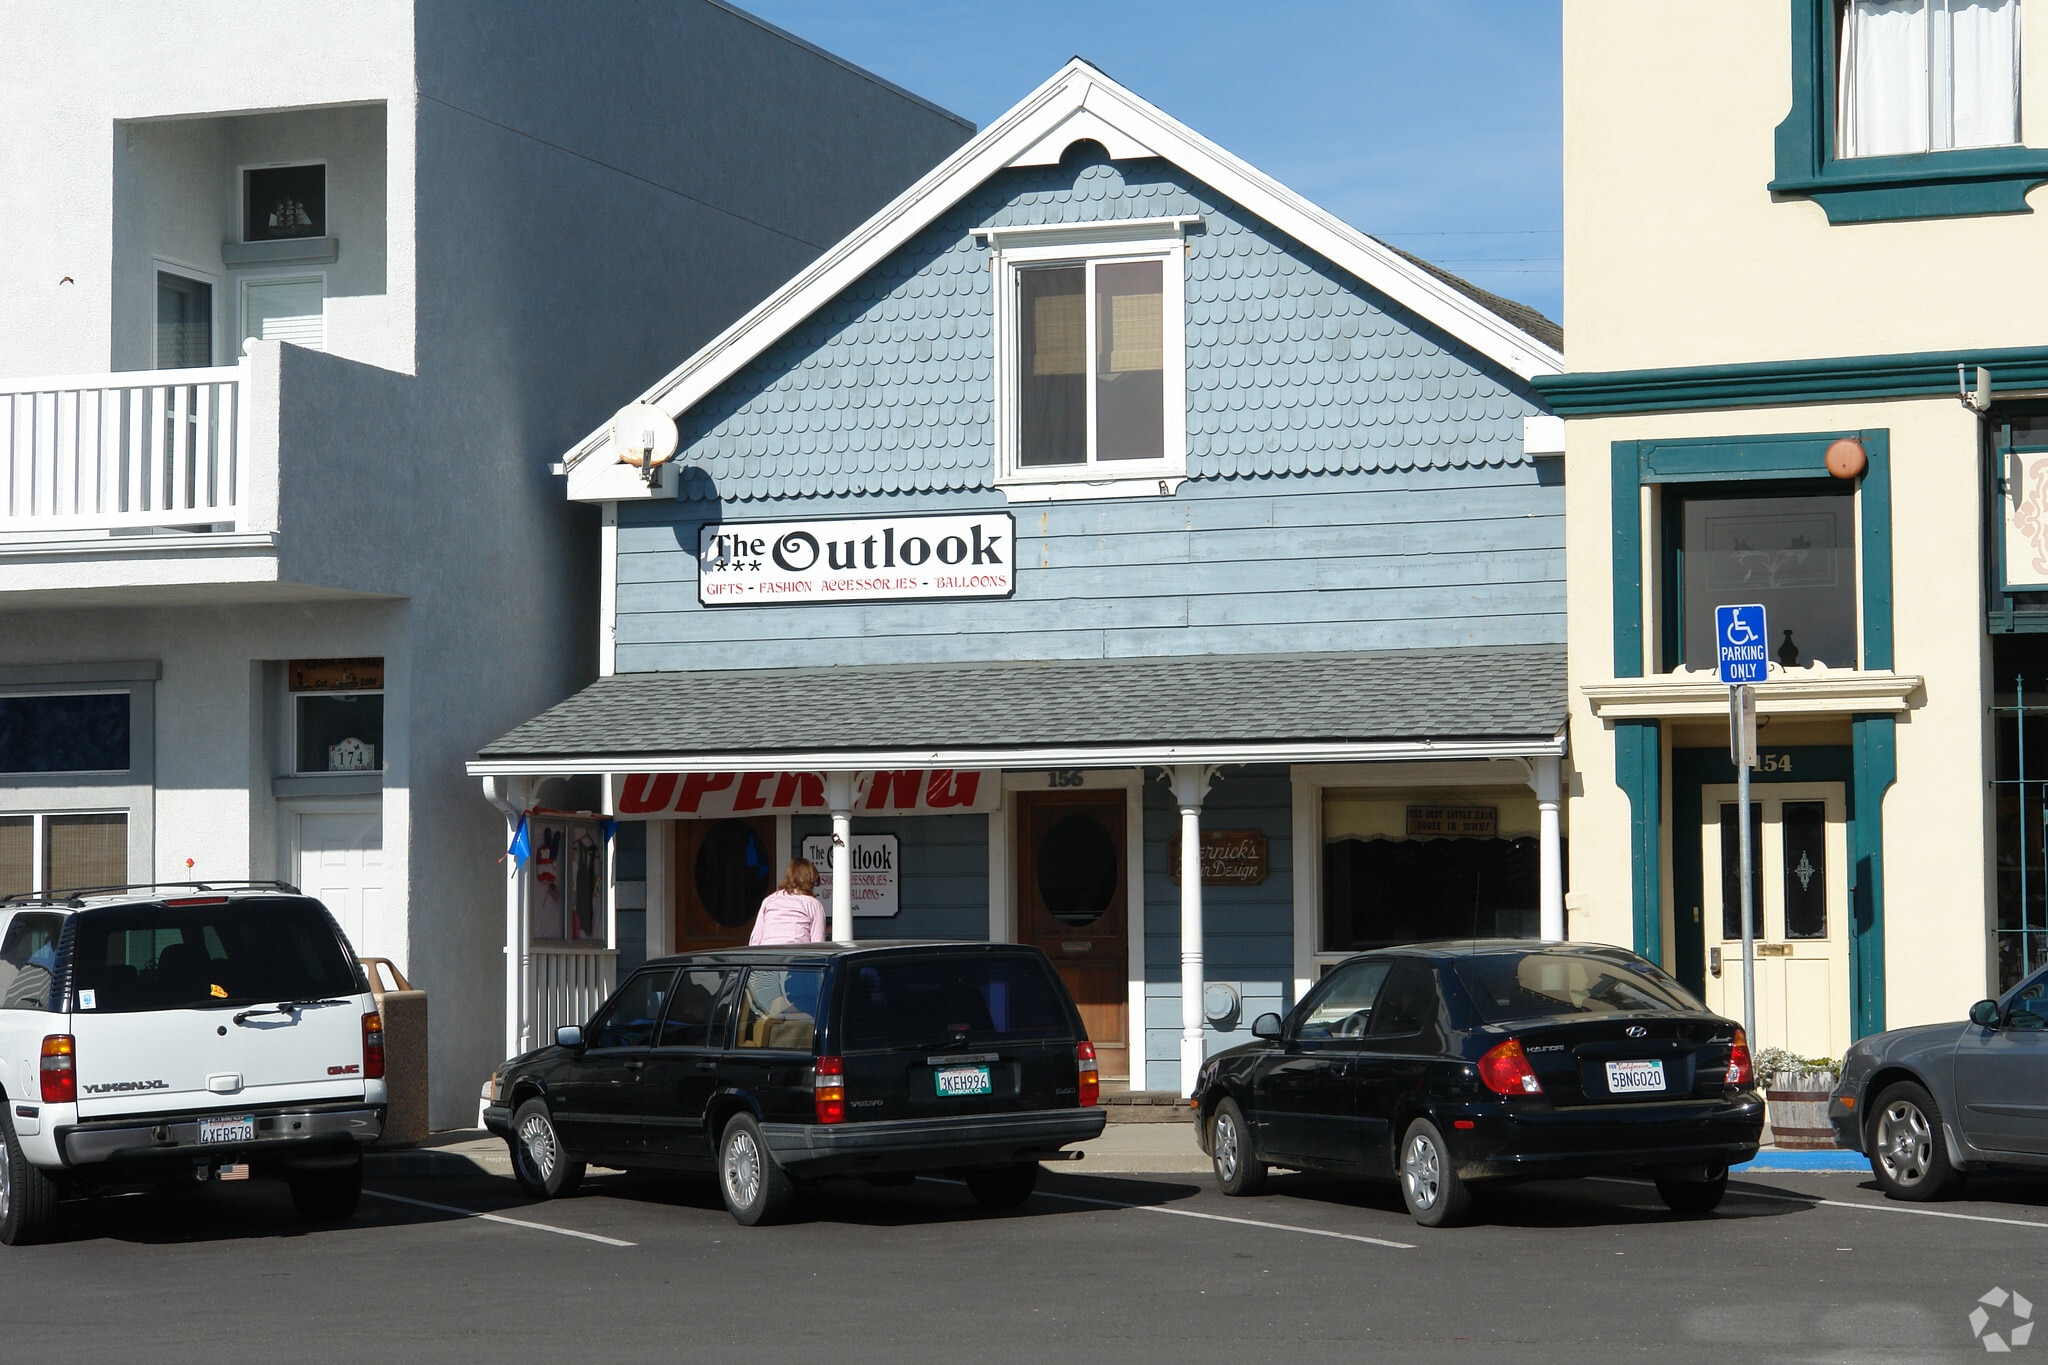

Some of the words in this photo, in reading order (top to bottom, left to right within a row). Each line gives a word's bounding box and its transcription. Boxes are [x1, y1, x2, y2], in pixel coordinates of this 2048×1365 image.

[710, 532, 766, 559] The
[772, 523, 1004, 572] Outlook
[706, 582, 744, 596] GIFTS
[759, 580, 813, 594] FASHION
[820, 577, 918, 592] ACCESSORIES
[934, 575, 1008, 589] BALLOONS
[1721, 645, 1764, 662] PARKING
[1730, 663, 1757, 679] ONLY
[339, 751, 363, 765] 174
[1752, 754, 1792, 772] 154
[1048, 770, 1084, 788] 156
[618, 769, 981, 813] OPENNG
[1447, 810, 1472, 819] LITTLE
[1474, 811, 1494, 820] HAIR
[1417, 821, 1442, 831] HOUSE
[1447, 822, 1457, 831] IN
[809, 845, 825, 860] The
[827, 843, 892, 870] tlook
[1180, 839, 1260, 860] ernick's
[1212, 859, 1258, 881] Design
[327, 1064, 360, 1075] GMC
[1618, 1062, 1652, 1071] California
[82, 1081, 145, 1094] YUKON
[145, 1080, 170, 1090] XL
[940, 1074, 988, 1092] 3KEH996
[1611, 1071, 1662, 1088] 5BNG020
[850, 1099, 884, 1109] VOLVO
